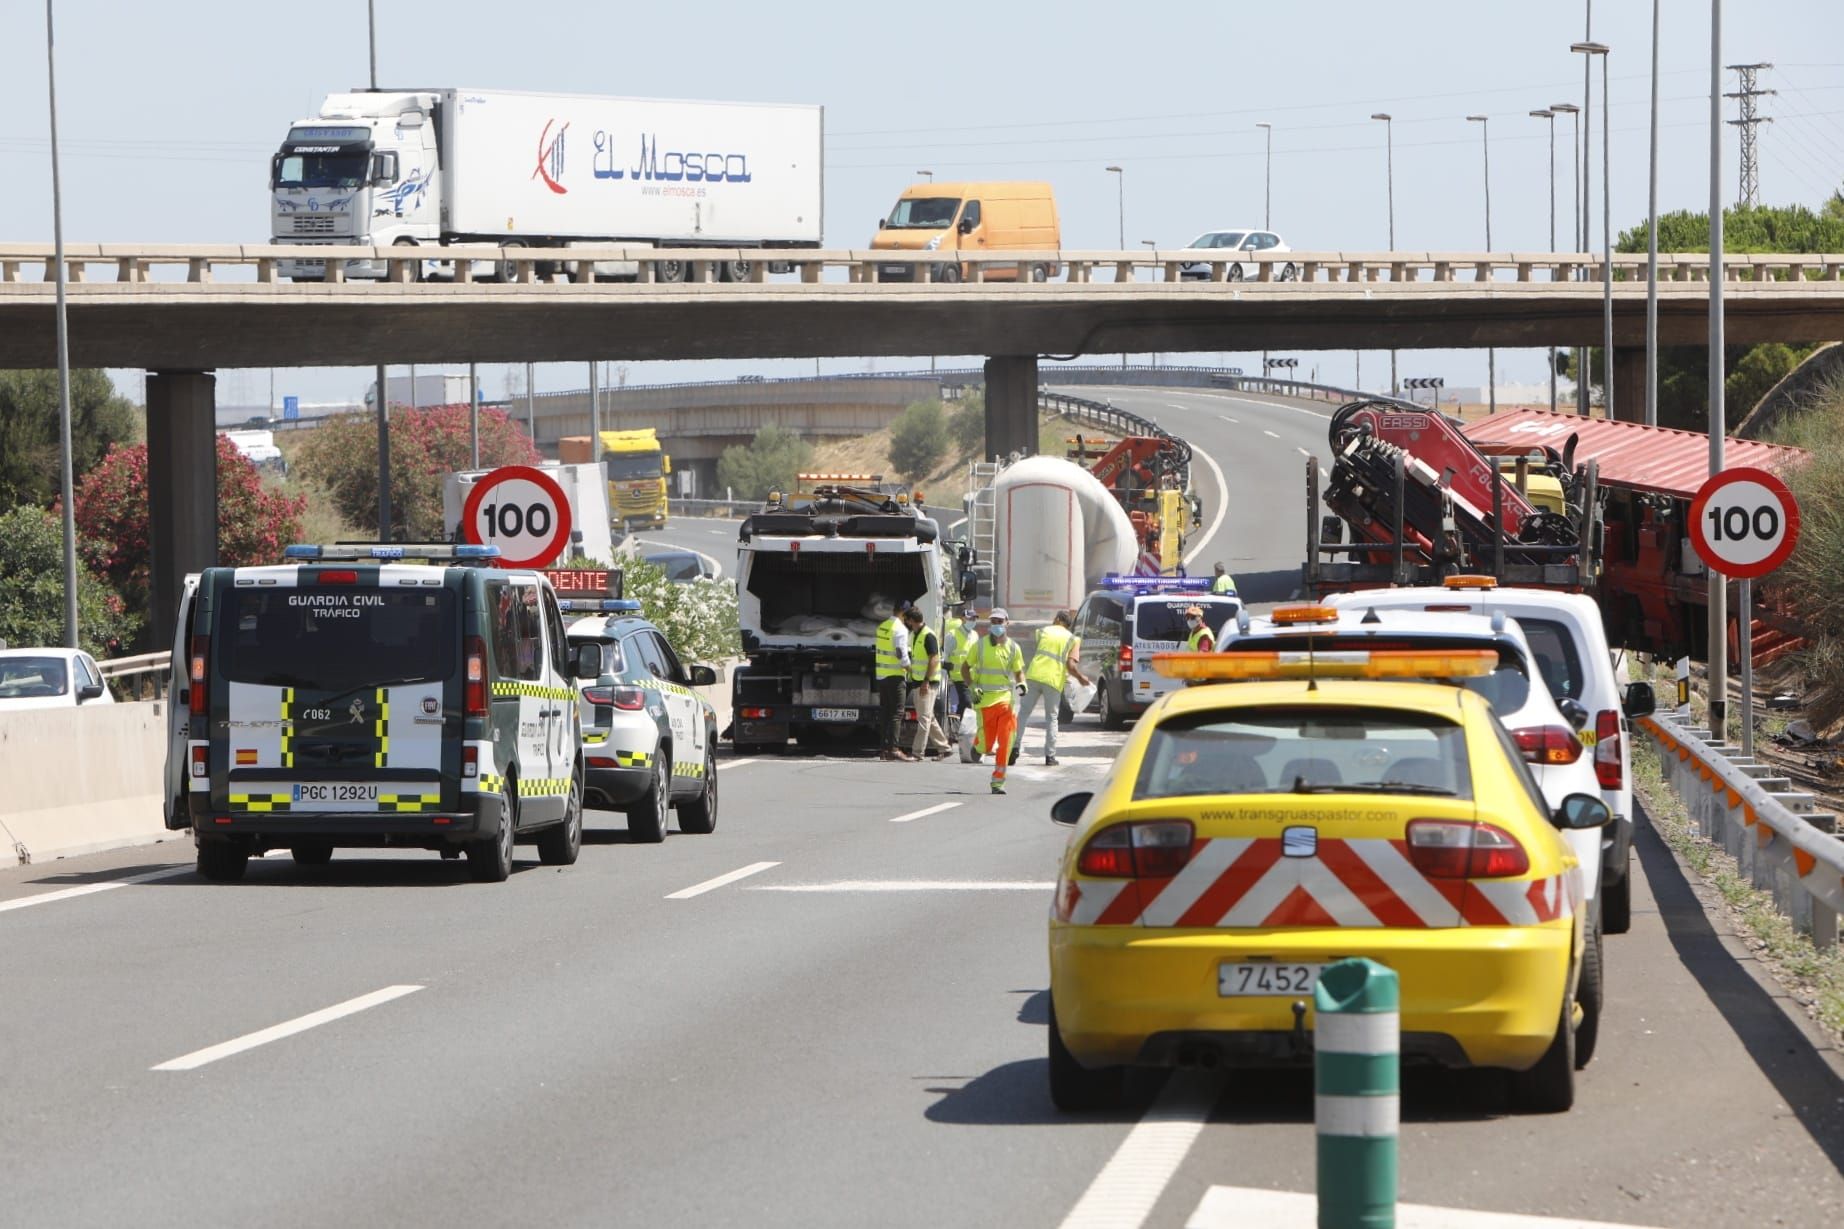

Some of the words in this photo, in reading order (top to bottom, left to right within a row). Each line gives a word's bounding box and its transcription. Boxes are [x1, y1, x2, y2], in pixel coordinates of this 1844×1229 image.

[1382, 416, 1426, 429] FASSI
[483, 502, 551, 538] 100
[1708, 505, 1779, 541] 100
[288, 595, 348, 606] GUARDIA
[353, 595, 385, 606] CIVIL
[1134, 641, 1177, 650] ATESTADOS
[311, 709, 331, 720] 062
[818, 710, 839, 719] 6617
[840, 710, 857, 719] KRN
[301, 785, 327, 800] PGC
[1200, 808, 1398, 823] www.transgruaspastor.com
[1238, 966, 1310, 992] 7452
